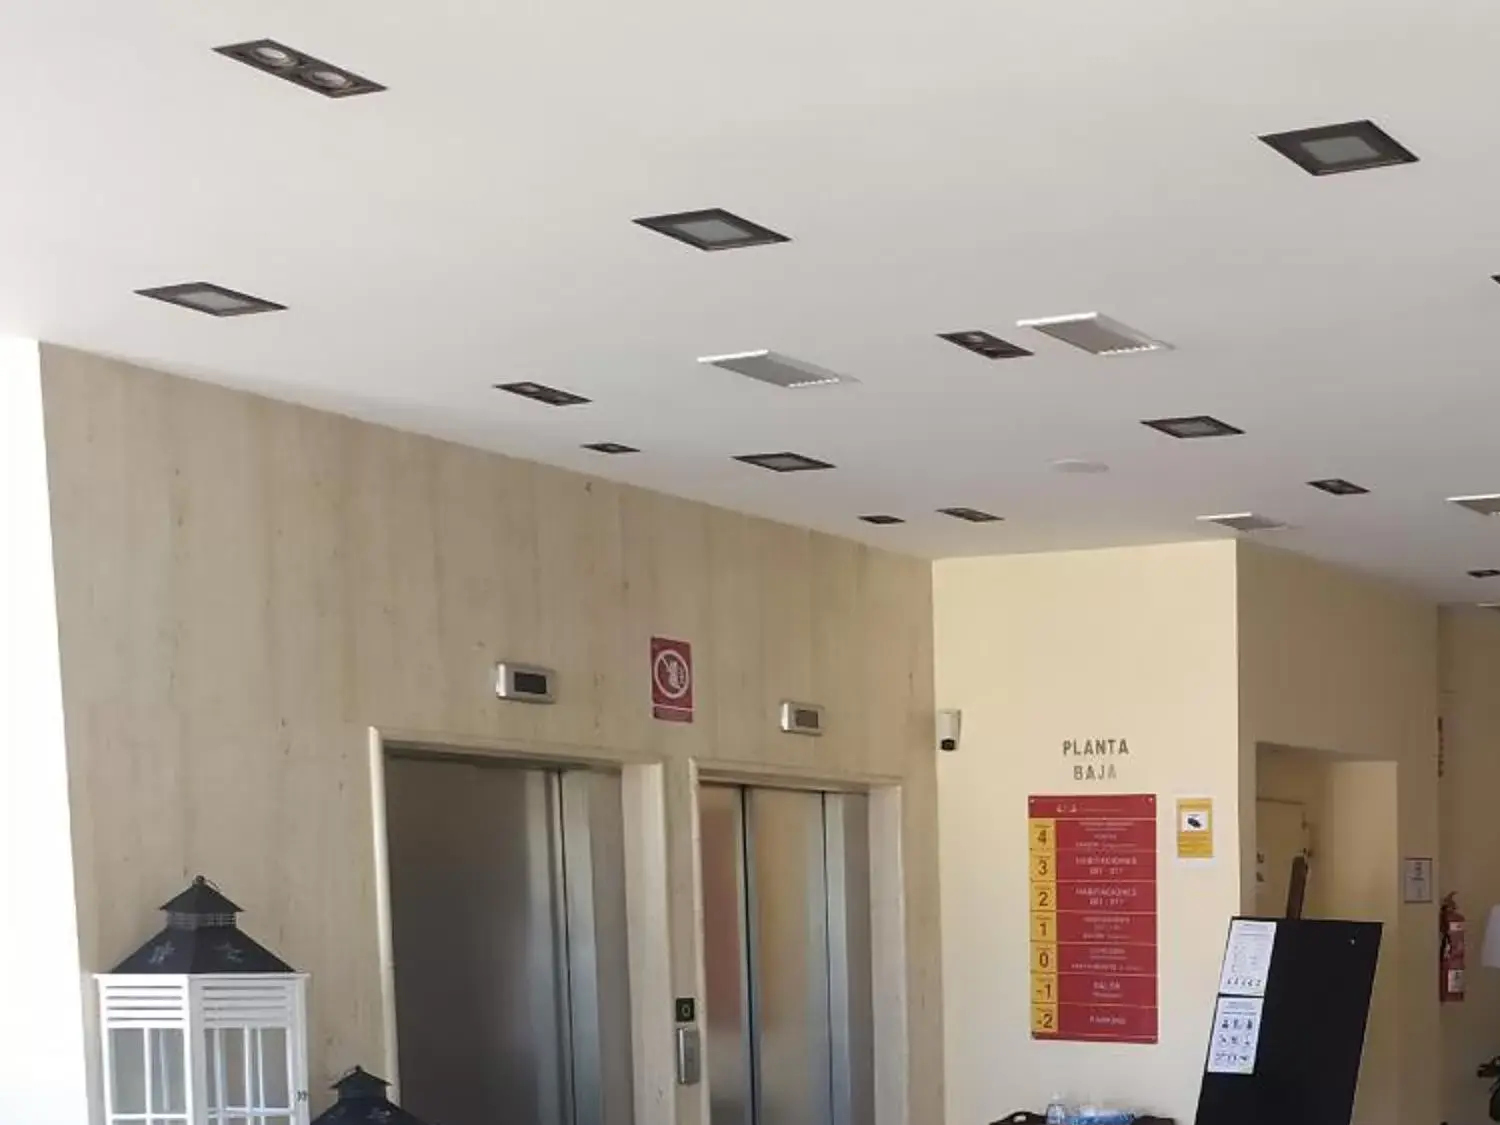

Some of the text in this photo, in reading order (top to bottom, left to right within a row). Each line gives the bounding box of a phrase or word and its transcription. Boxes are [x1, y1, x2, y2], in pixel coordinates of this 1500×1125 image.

[1062, 738, 1130, 756] PLANTA
[1073, 764, 1118, 781] BAJA
[1037, 829, 1048, 845] 4
[1038, 859, 1048, 876] 3
[1038, 891, 1049, 907] 2
[1040, 922, 1048, 937] 1
[1039, 952, 1049, 968] 0
[1036, 983, 1052, 1000] -1
[1036, 1013, 1053, 1029] -2
